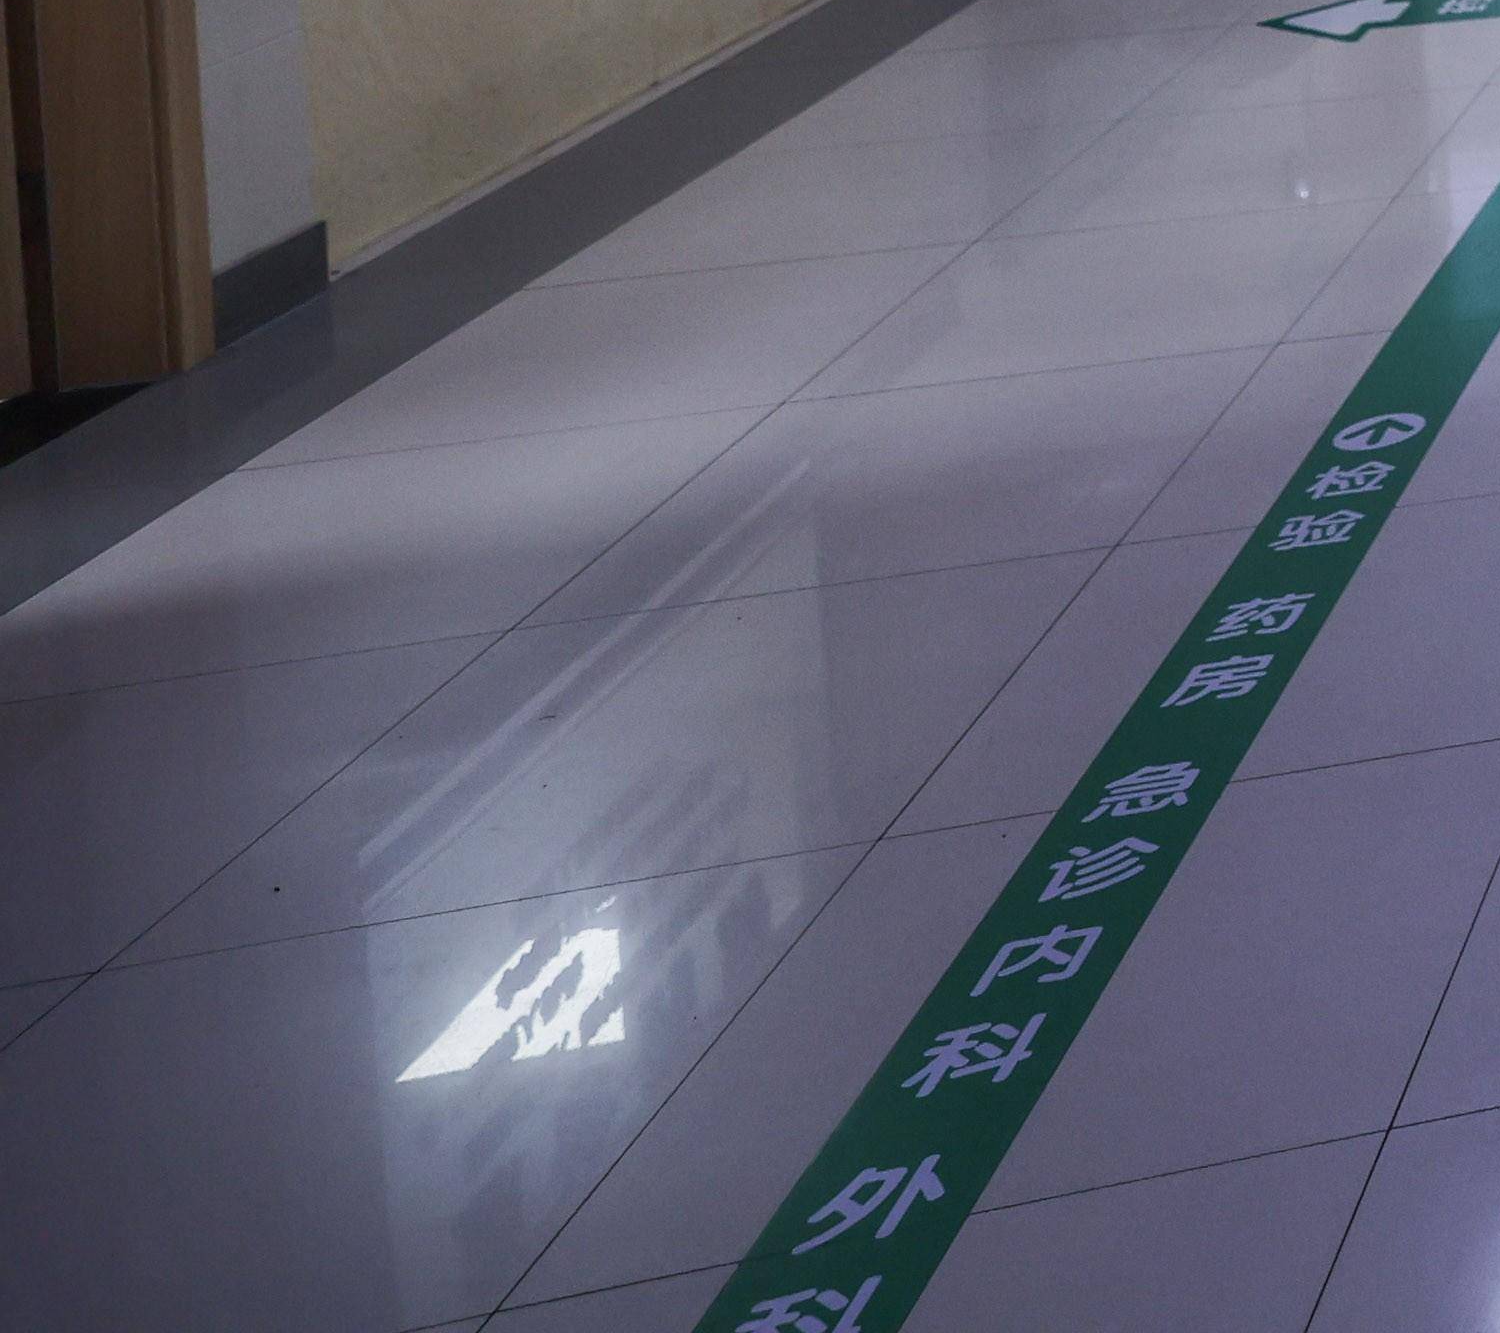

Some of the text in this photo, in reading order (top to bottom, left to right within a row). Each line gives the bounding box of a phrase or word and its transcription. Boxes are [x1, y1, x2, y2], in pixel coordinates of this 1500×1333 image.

[1266, 460, 1395, 553] 检验
[1161, 592, 1316, 709] 药房
[900, 759, 1200, 1099] 急诊内科
